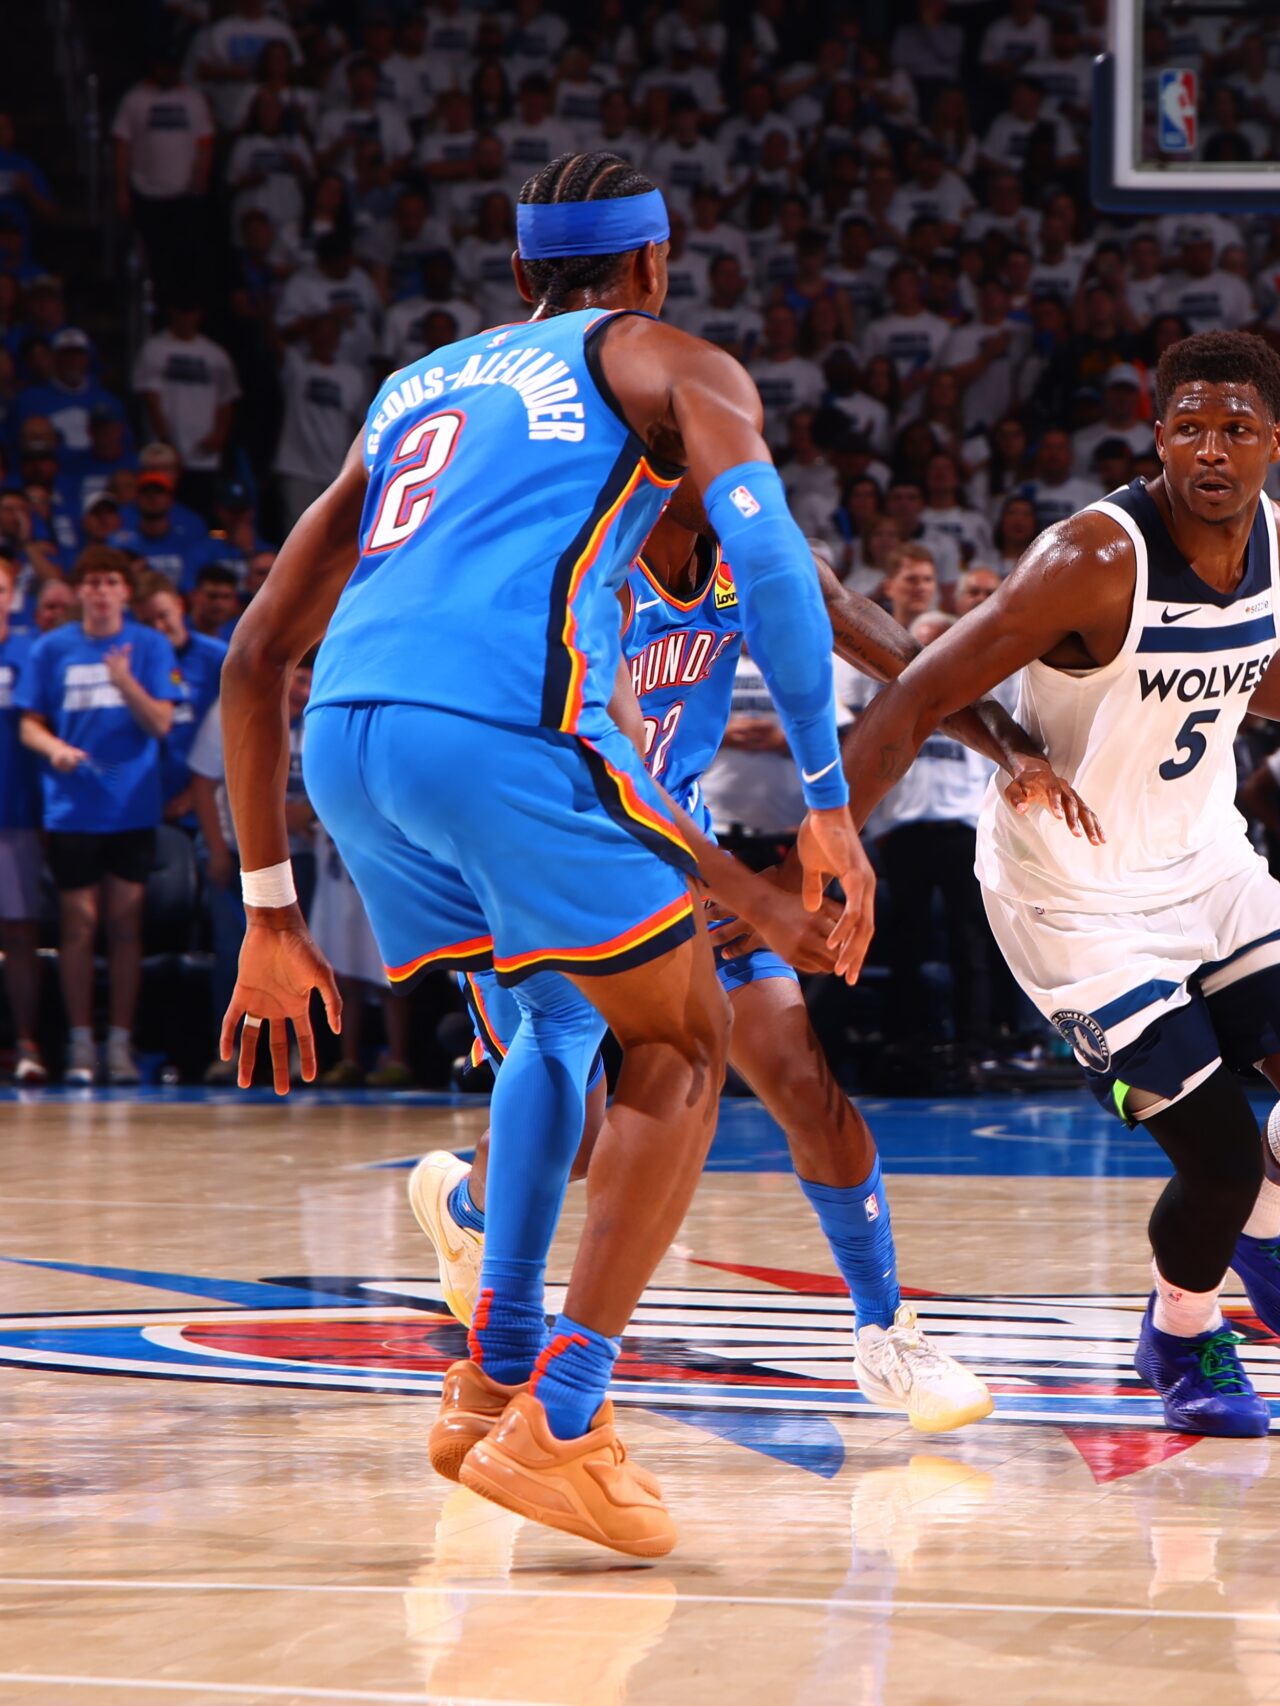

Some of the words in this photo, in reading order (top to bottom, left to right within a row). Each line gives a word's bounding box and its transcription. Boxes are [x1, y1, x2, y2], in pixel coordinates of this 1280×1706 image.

[363, 409, 466, 556] 2
[1138, 654, 1271, 703] WOLVES
[1159, 708, 1222, 781] 5
